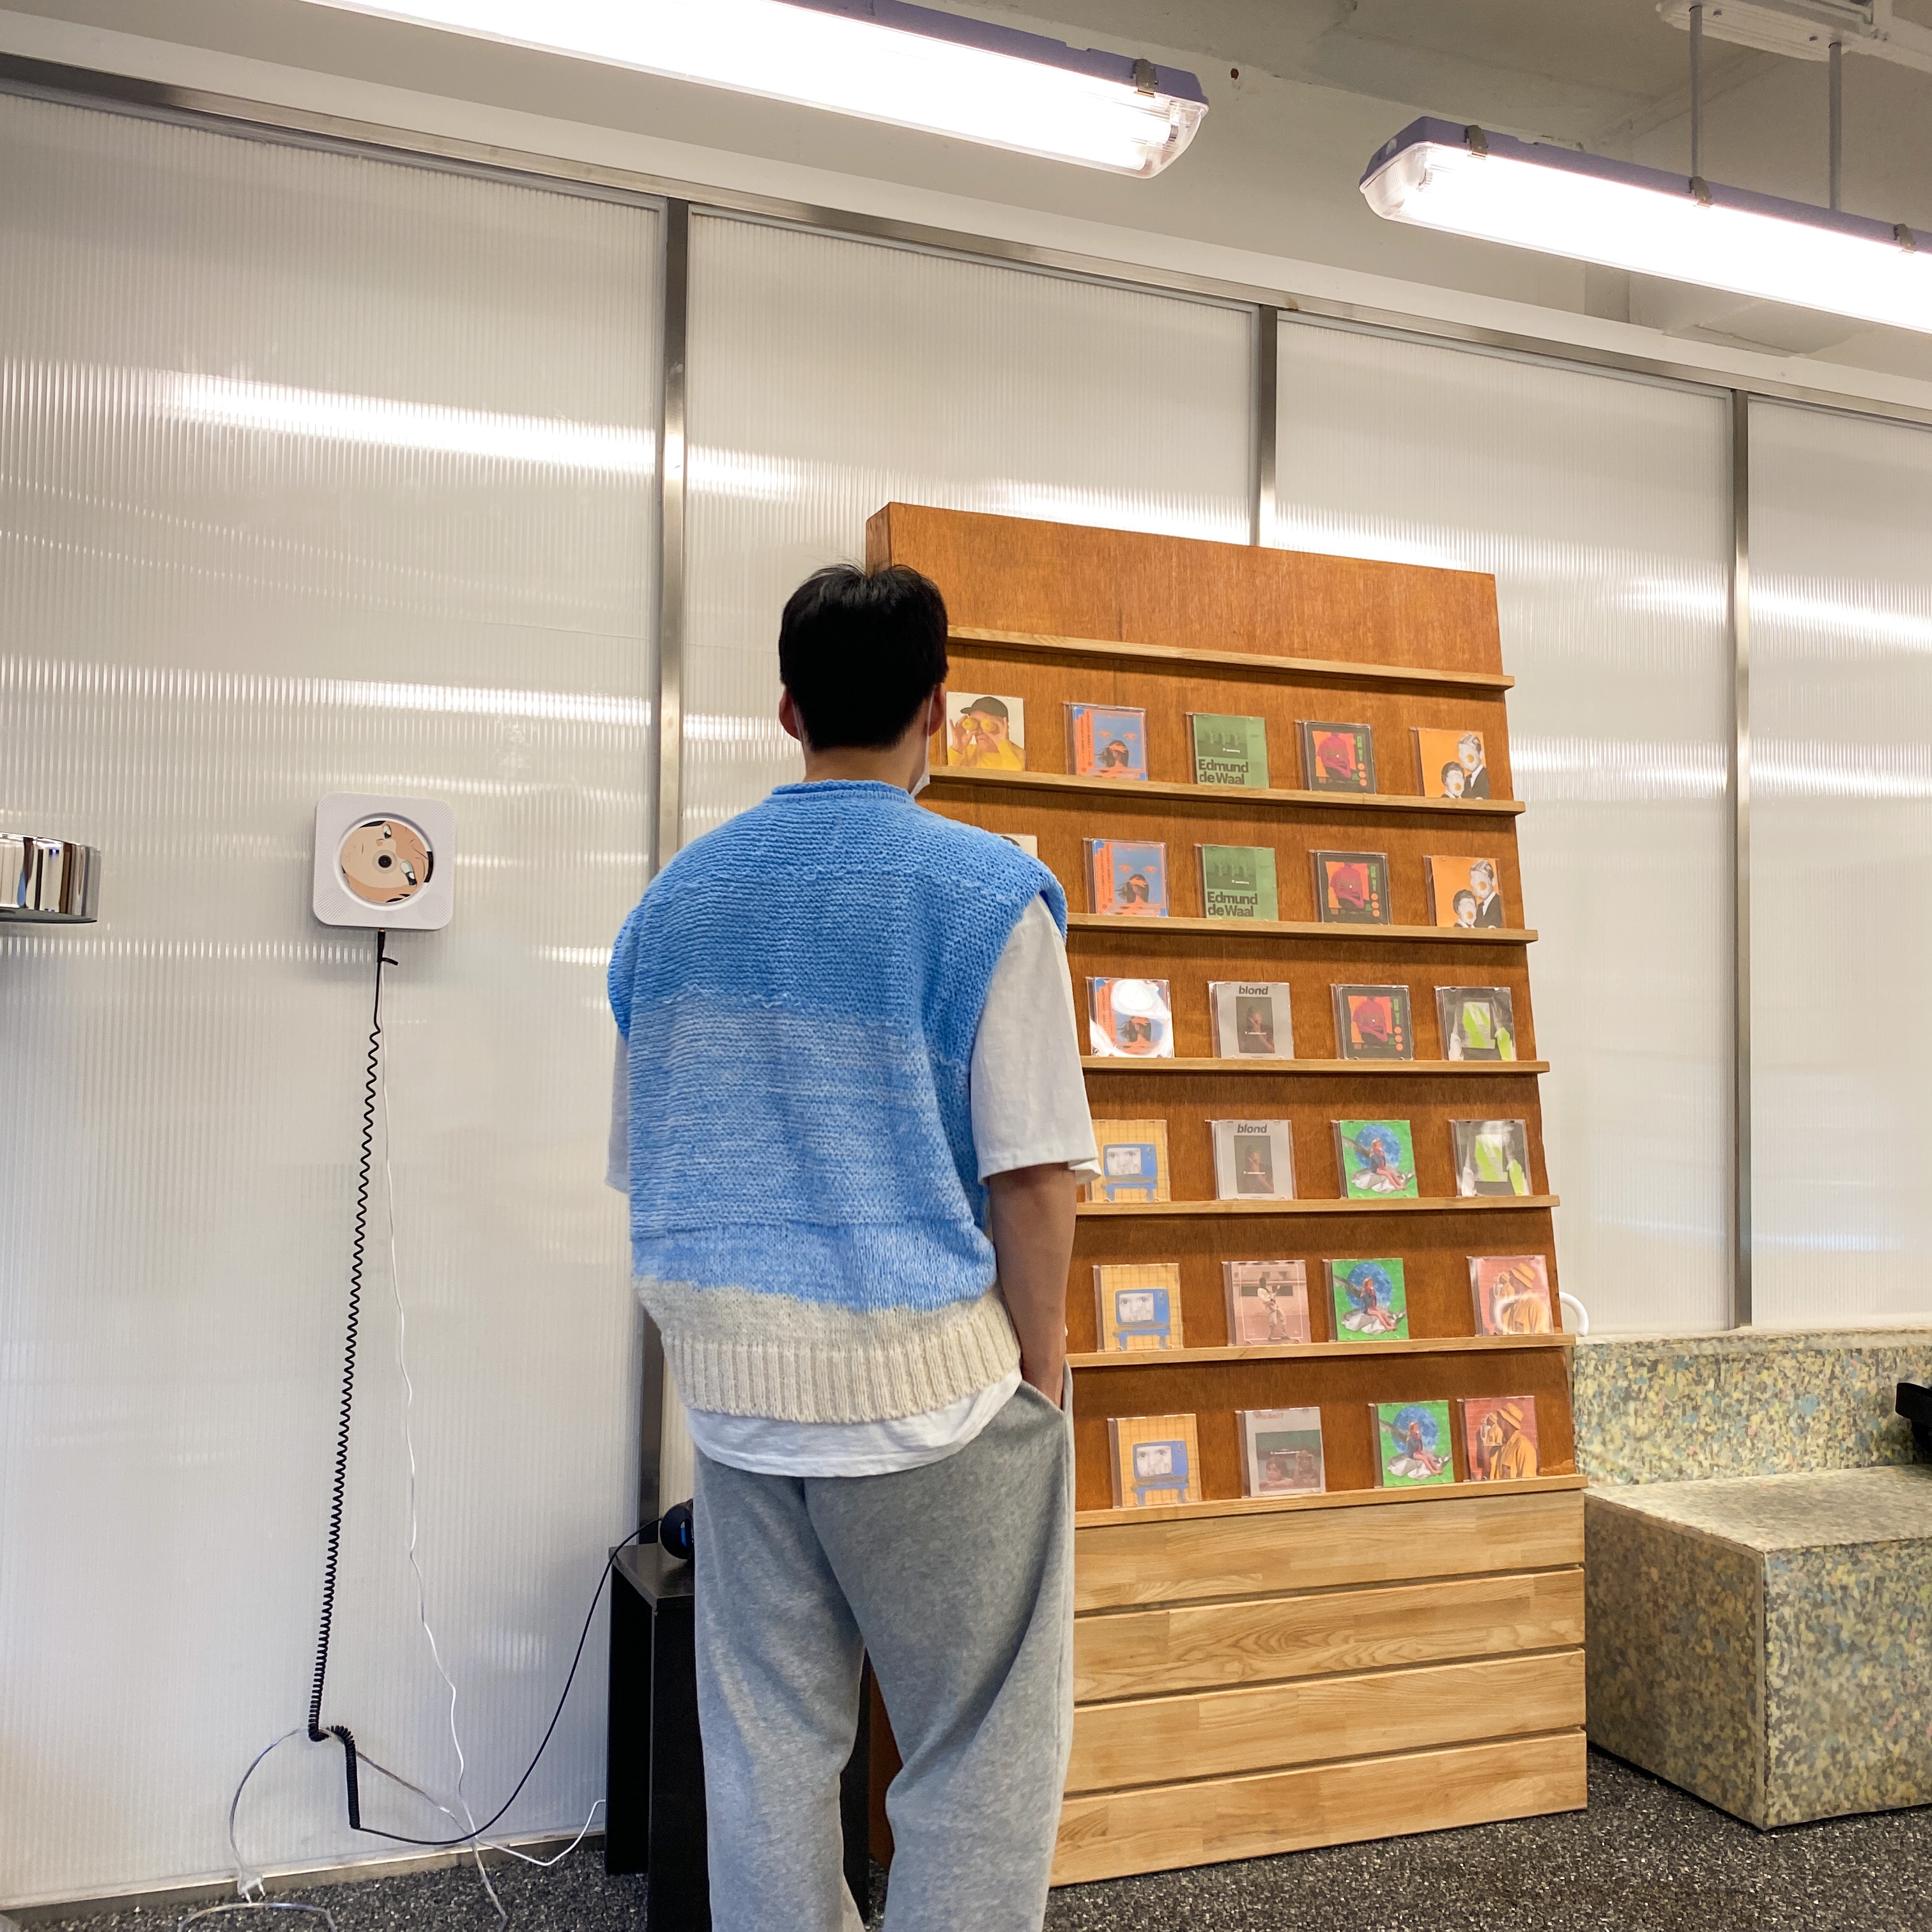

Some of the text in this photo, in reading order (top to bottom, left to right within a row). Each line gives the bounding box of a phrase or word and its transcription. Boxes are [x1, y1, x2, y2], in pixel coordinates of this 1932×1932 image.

[1199, 759, 1249, 773] Edmund
[1207, 891, 1258, 905] Edmund
[1239, 985, 1269, 995] blond
[1237, 1124, 1268, 1133] blond
